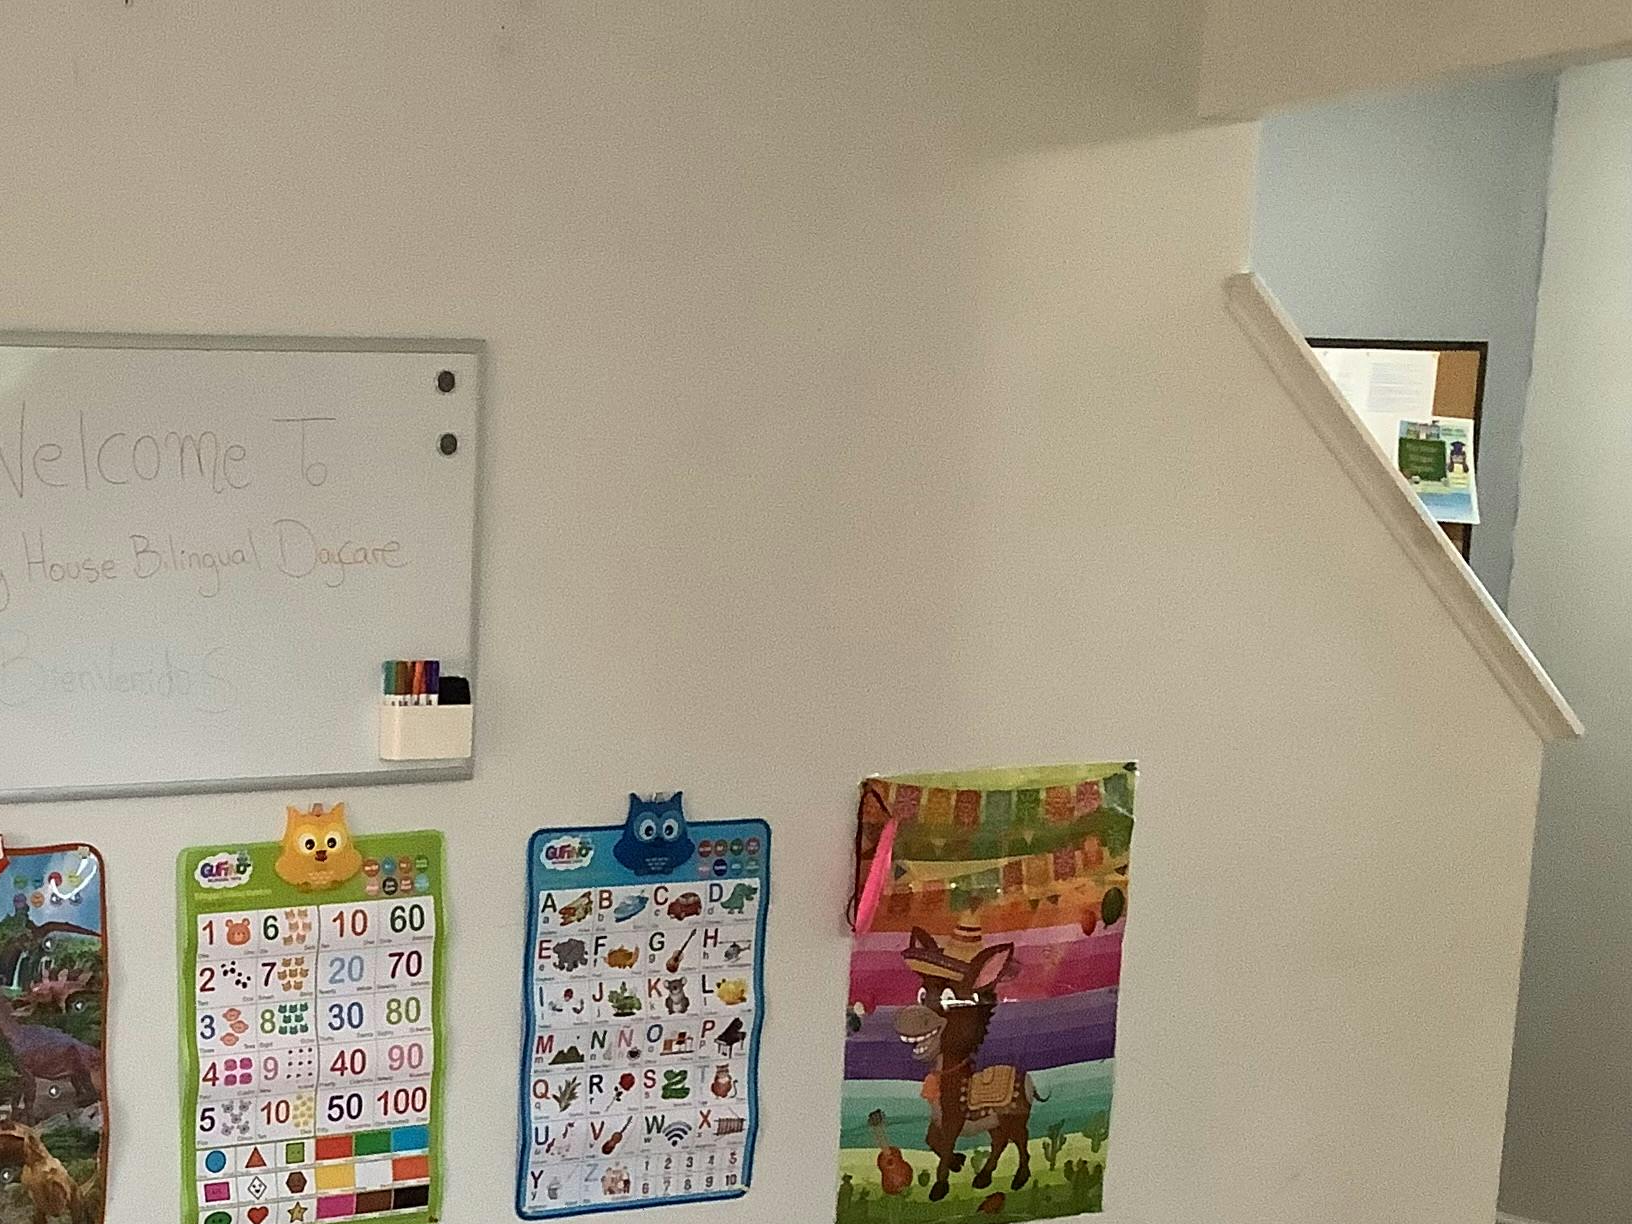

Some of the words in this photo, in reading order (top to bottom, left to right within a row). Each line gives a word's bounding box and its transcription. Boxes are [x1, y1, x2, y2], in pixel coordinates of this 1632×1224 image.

[272, 417, 337, 487] To
[22, 528, 117, 583] House
[129, 527, 261, 598] Bilingual
[272, 518, 409, 588] Daycare
[599, 890, 613, 909] B
[654, 886, 669, 905] C
[709, 883, 723, 902] D
[541, 893, 557, 913] A
[708, 907, 714, 915] d
[263, 915, 279, 940] 6
[332, 909, 368, 937] 10
[390, 904, 425, 933] 60
[598, 913, 604, 922] b
[202, 920, 213, 945] 1
[649, 932, 665, 951] G
[703, 928, 718, 948] H
[538, 940, 552, 959] E
[594, 936, 607, 955] F
[261, 962, 277, 987] 7
[329, 955, 364, 984] 20
[388, 950, 422, 979] 70
[200, 967, 215, 992] 2
[648, 978, 662, 998] K
[702, 974, 714, 993] L
[592, 982, 603, 1002] J
[260, 1009, 275, 1033] 8
[328, 1002, 364, 1031] 30
[386, 997, 421, 1025] 80
[200, 1015, 215, 1040] 3
[647, 1024, 663, 1043] O
[701, 1020, 715, 1038] P
[536, 1034, 554, 1054] M
[591, 1030, 607, 1049] N
[699, 1041, 706, 1049] p
[330, 1049, 366, 1076] 40
[388, 1043, 423, 1071] 90
[202, 1062, 219, 1086] 4
[263, 1056, 279, 1080] 9
[589, 1075, 603, 1094] R
[644, 1069, 656, 1088] S
[533, 1079, 550, 1099] Q
[328, 1093, 363, 1122] 50
[377, 1087, 427, 1116] 100
[200, 1107, 215, 1132] 5
[261, 1100, 290, 1125] 10
[699, 1109, 711, 1129] X
[591, 1121, 604, 1140] V
[645, 1114, 665, 1134] W
[535, 1126, 549, 1145] U
[664, 1157, 672, 1169] 2
[686, 1157, 693, 1168] 3
[708, 1155, 714, 1165] 4
[729, 1152, 737, 1164] 5
[531, 1170, 543, 1189] Y
[642, 1183, 649, 1194] 6
[684, 1179, 692, 1190] 8
[706, 1176, 713, 1187] 9
[726, 1174, 737, 1186] 10
[531, 1191, 537, 1200] y
